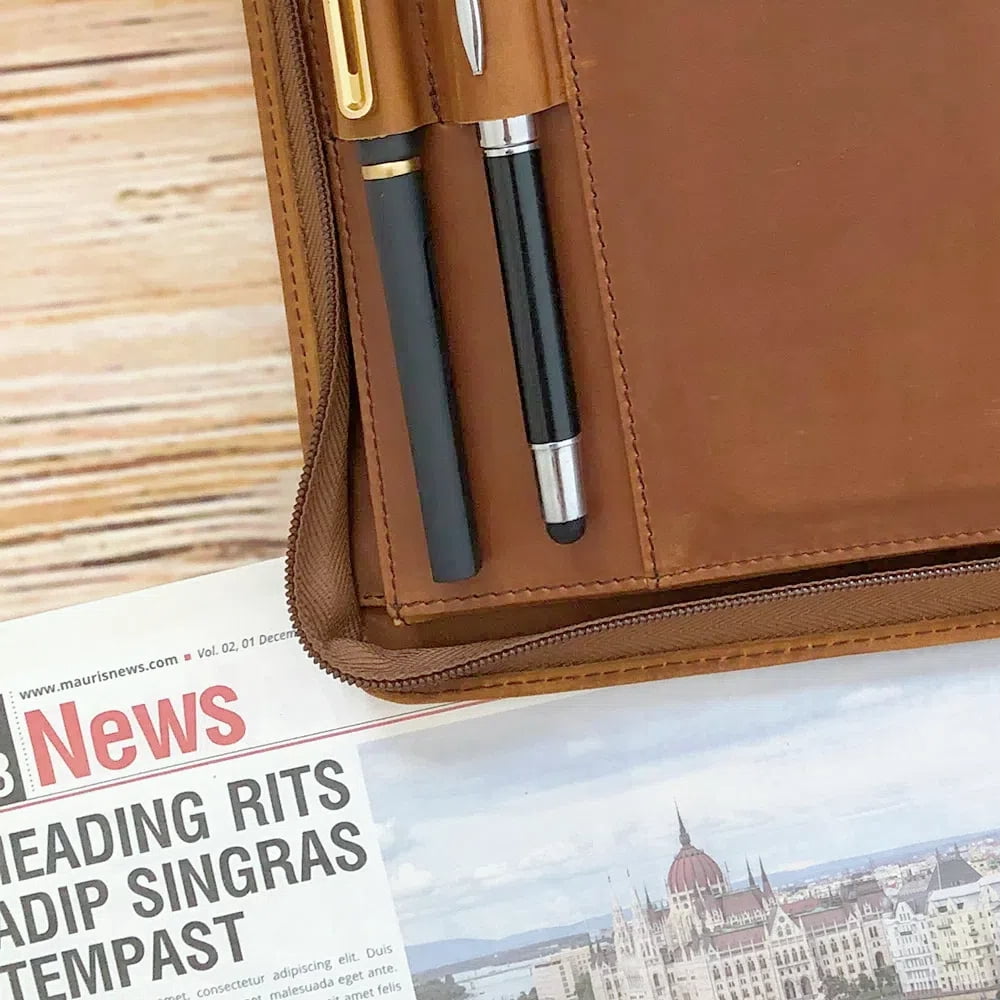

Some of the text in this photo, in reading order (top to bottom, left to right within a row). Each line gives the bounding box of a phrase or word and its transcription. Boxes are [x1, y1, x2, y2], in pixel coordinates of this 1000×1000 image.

[19, 655, 179, 700] www.maurisnews.com
[197, 645, 219, 659] Vol.
[222, 641, 239, 654] 02,
[242, 636, 255, 649] 01
[24, 685, 246, 787] News
[227, 759, 351, 832] RITS
[0, 821, 368, 948] ADIP SINGRAS
[0, 911, 245, 1000] TEMPAST
[197, 975, 265, 998] consectetur
[273, 958, 332, 981] adipiscing
[338, 952, 360, 965] elit.
[366, 944, 393, 958] Duis
[270, 964, 398, 1000] malesuada eget ante.
[377, 981, 402, 996] felis
